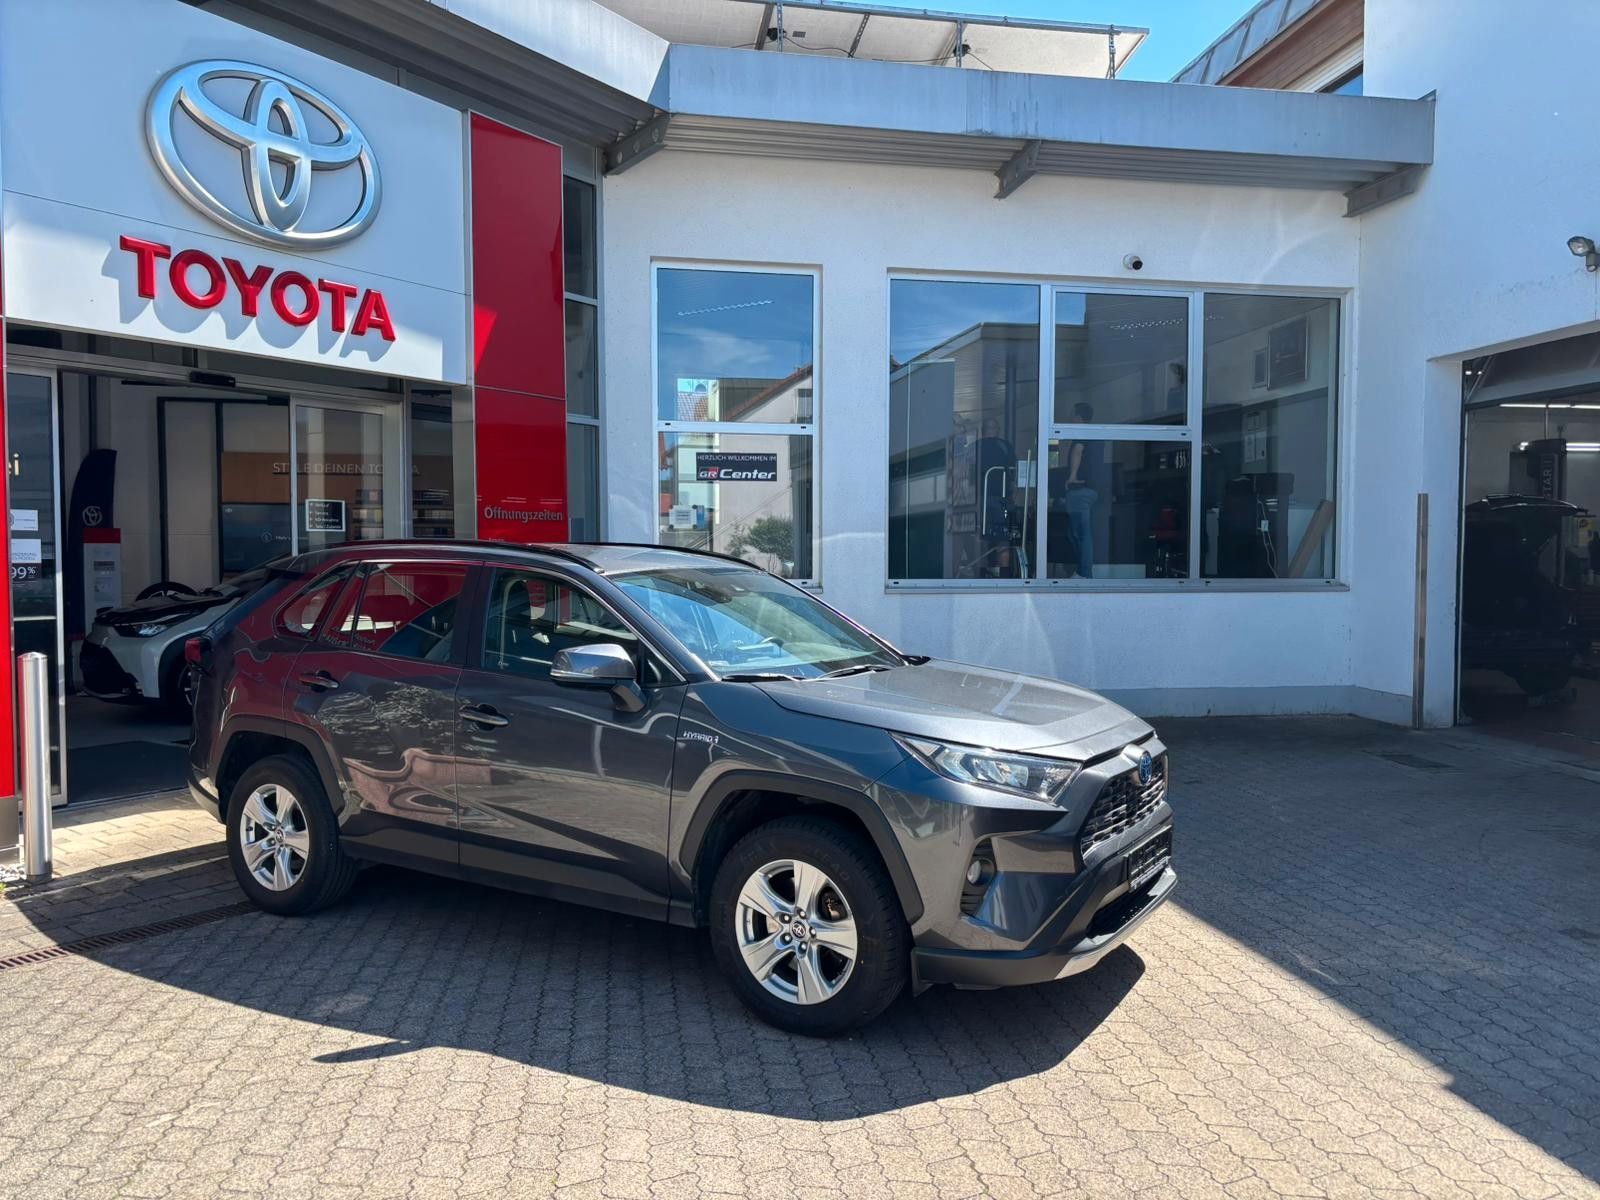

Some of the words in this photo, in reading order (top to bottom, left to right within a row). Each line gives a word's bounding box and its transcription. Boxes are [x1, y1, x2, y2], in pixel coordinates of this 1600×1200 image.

[119, 235, 396, 342] TOYOTA
[728, 454, 768, 462] WILLKOMMEN
[273, 462, 312, 474] STLE
[314, 463, 363, 475] DEINEN
[720, 469, 776, 479] Center
[483, 505, 563, 524] Öffnungszeiten
[683, 731, 713, 743] HYBRID
